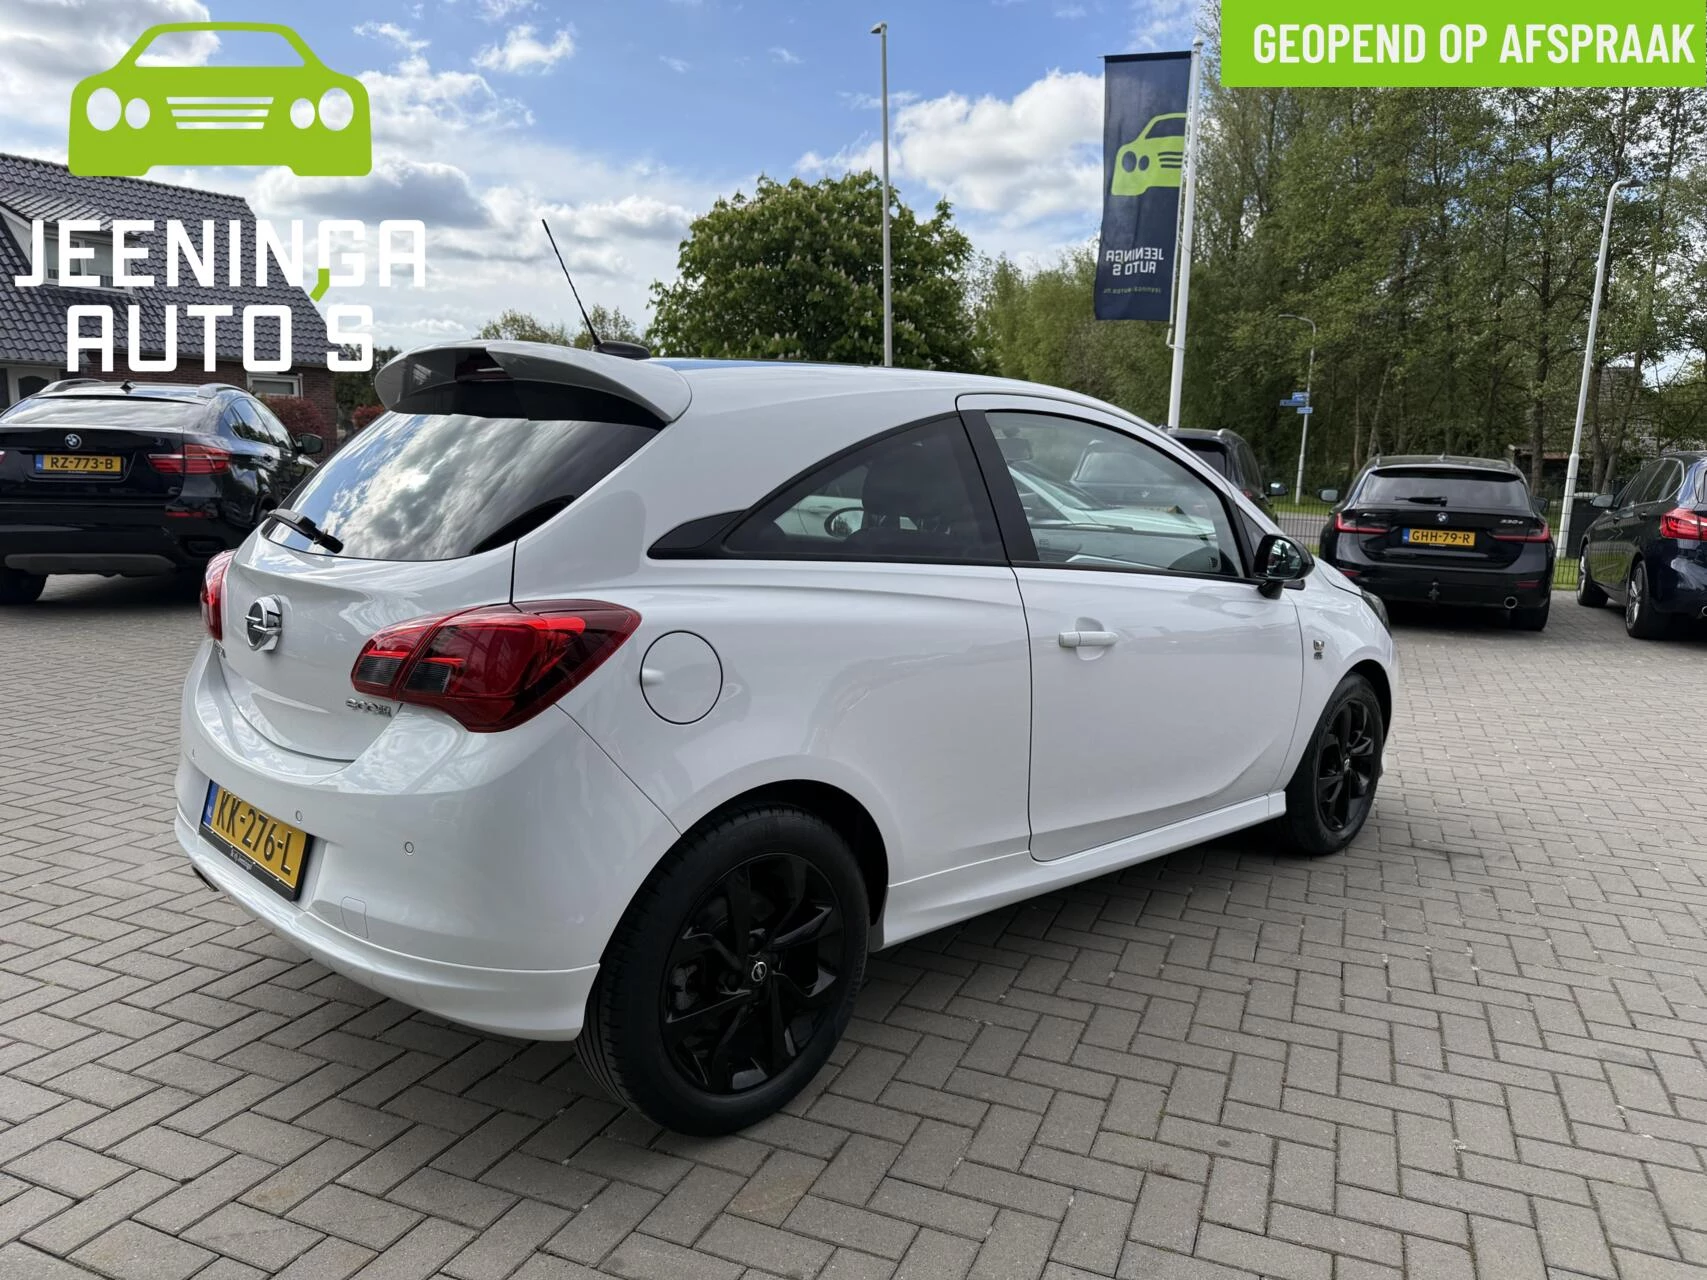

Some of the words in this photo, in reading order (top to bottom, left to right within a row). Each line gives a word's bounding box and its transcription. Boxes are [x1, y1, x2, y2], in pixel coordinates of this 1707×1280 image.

[50, 456, 114, 470] RZ-773-B
[1411, 530, 1471, 544] GHH-79-R
[216, 789, 292, 876] KK-276-L
